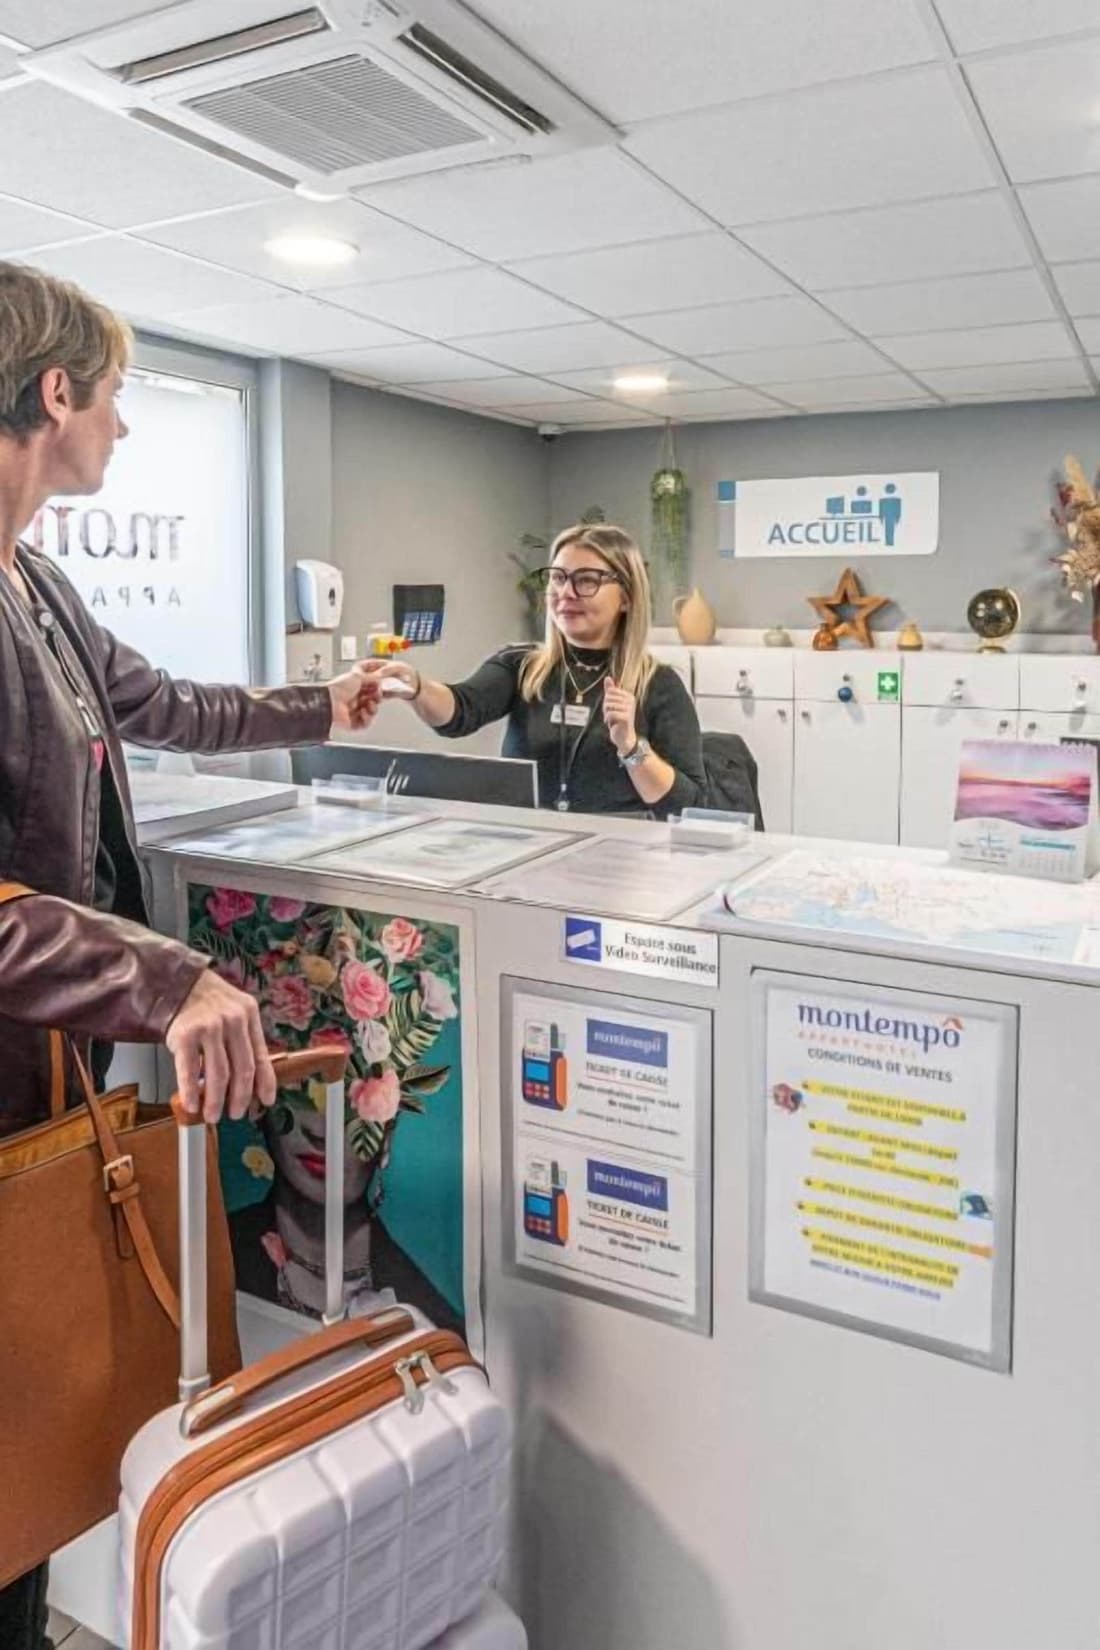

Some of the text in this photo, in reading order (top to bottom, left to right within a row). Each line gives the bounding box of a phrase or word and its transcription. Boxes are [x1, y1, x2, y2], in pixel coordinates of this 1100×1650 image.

[767, 521, 881, 545] ACCUEIL
[668, 942, 697, 955] sous
[641, 952, 717, 974] Surveillance
[797, 1003, 965, 1053] montempô
[807, 1048, 953, 1083] CONDITIONS DE VENTES
